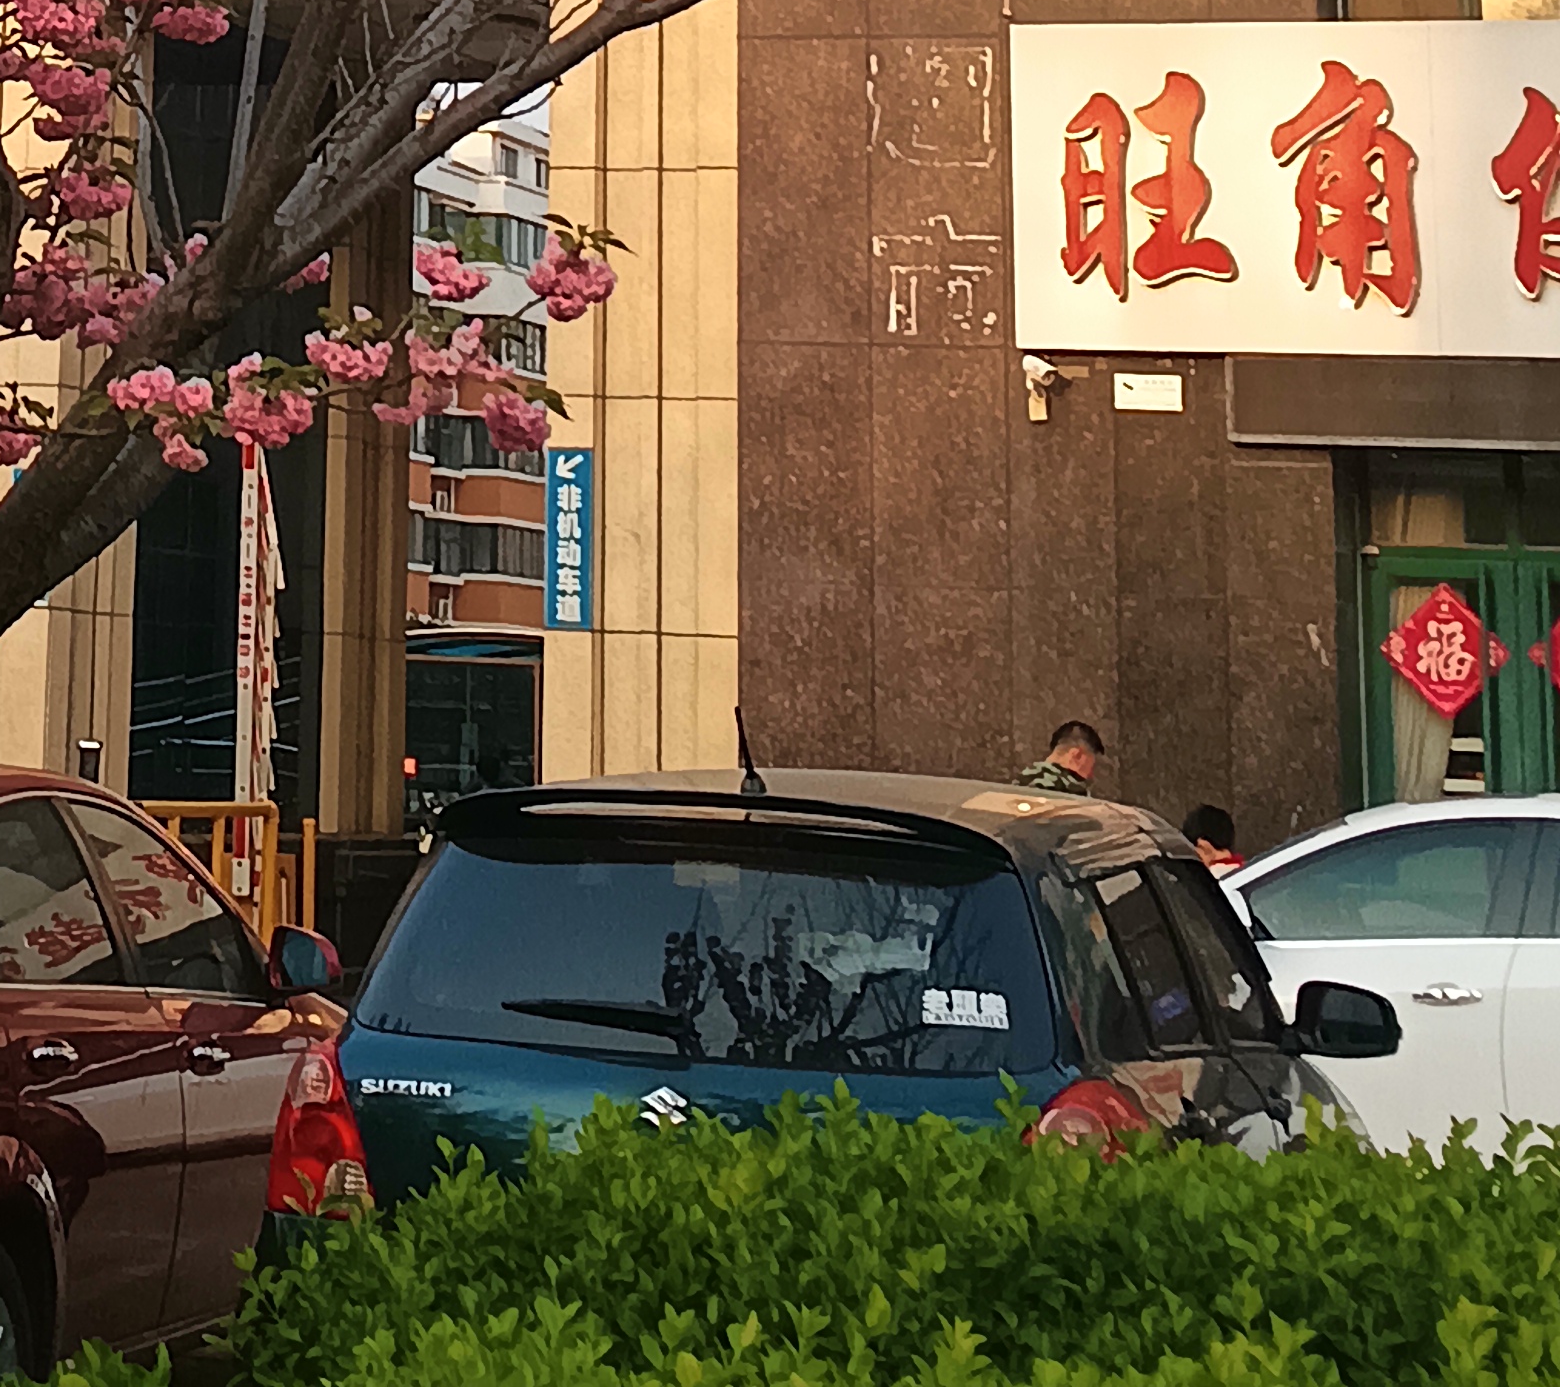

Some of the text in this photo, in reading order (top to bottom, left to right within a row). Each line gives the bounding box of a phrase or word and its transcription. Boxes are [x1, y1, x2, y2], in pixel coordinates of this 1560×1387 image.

[556, 483, 582, 622] 非机动车道
[1415, 619, 1478, 683] 福
[360, 1078, 452, 1097] SUZUKI
